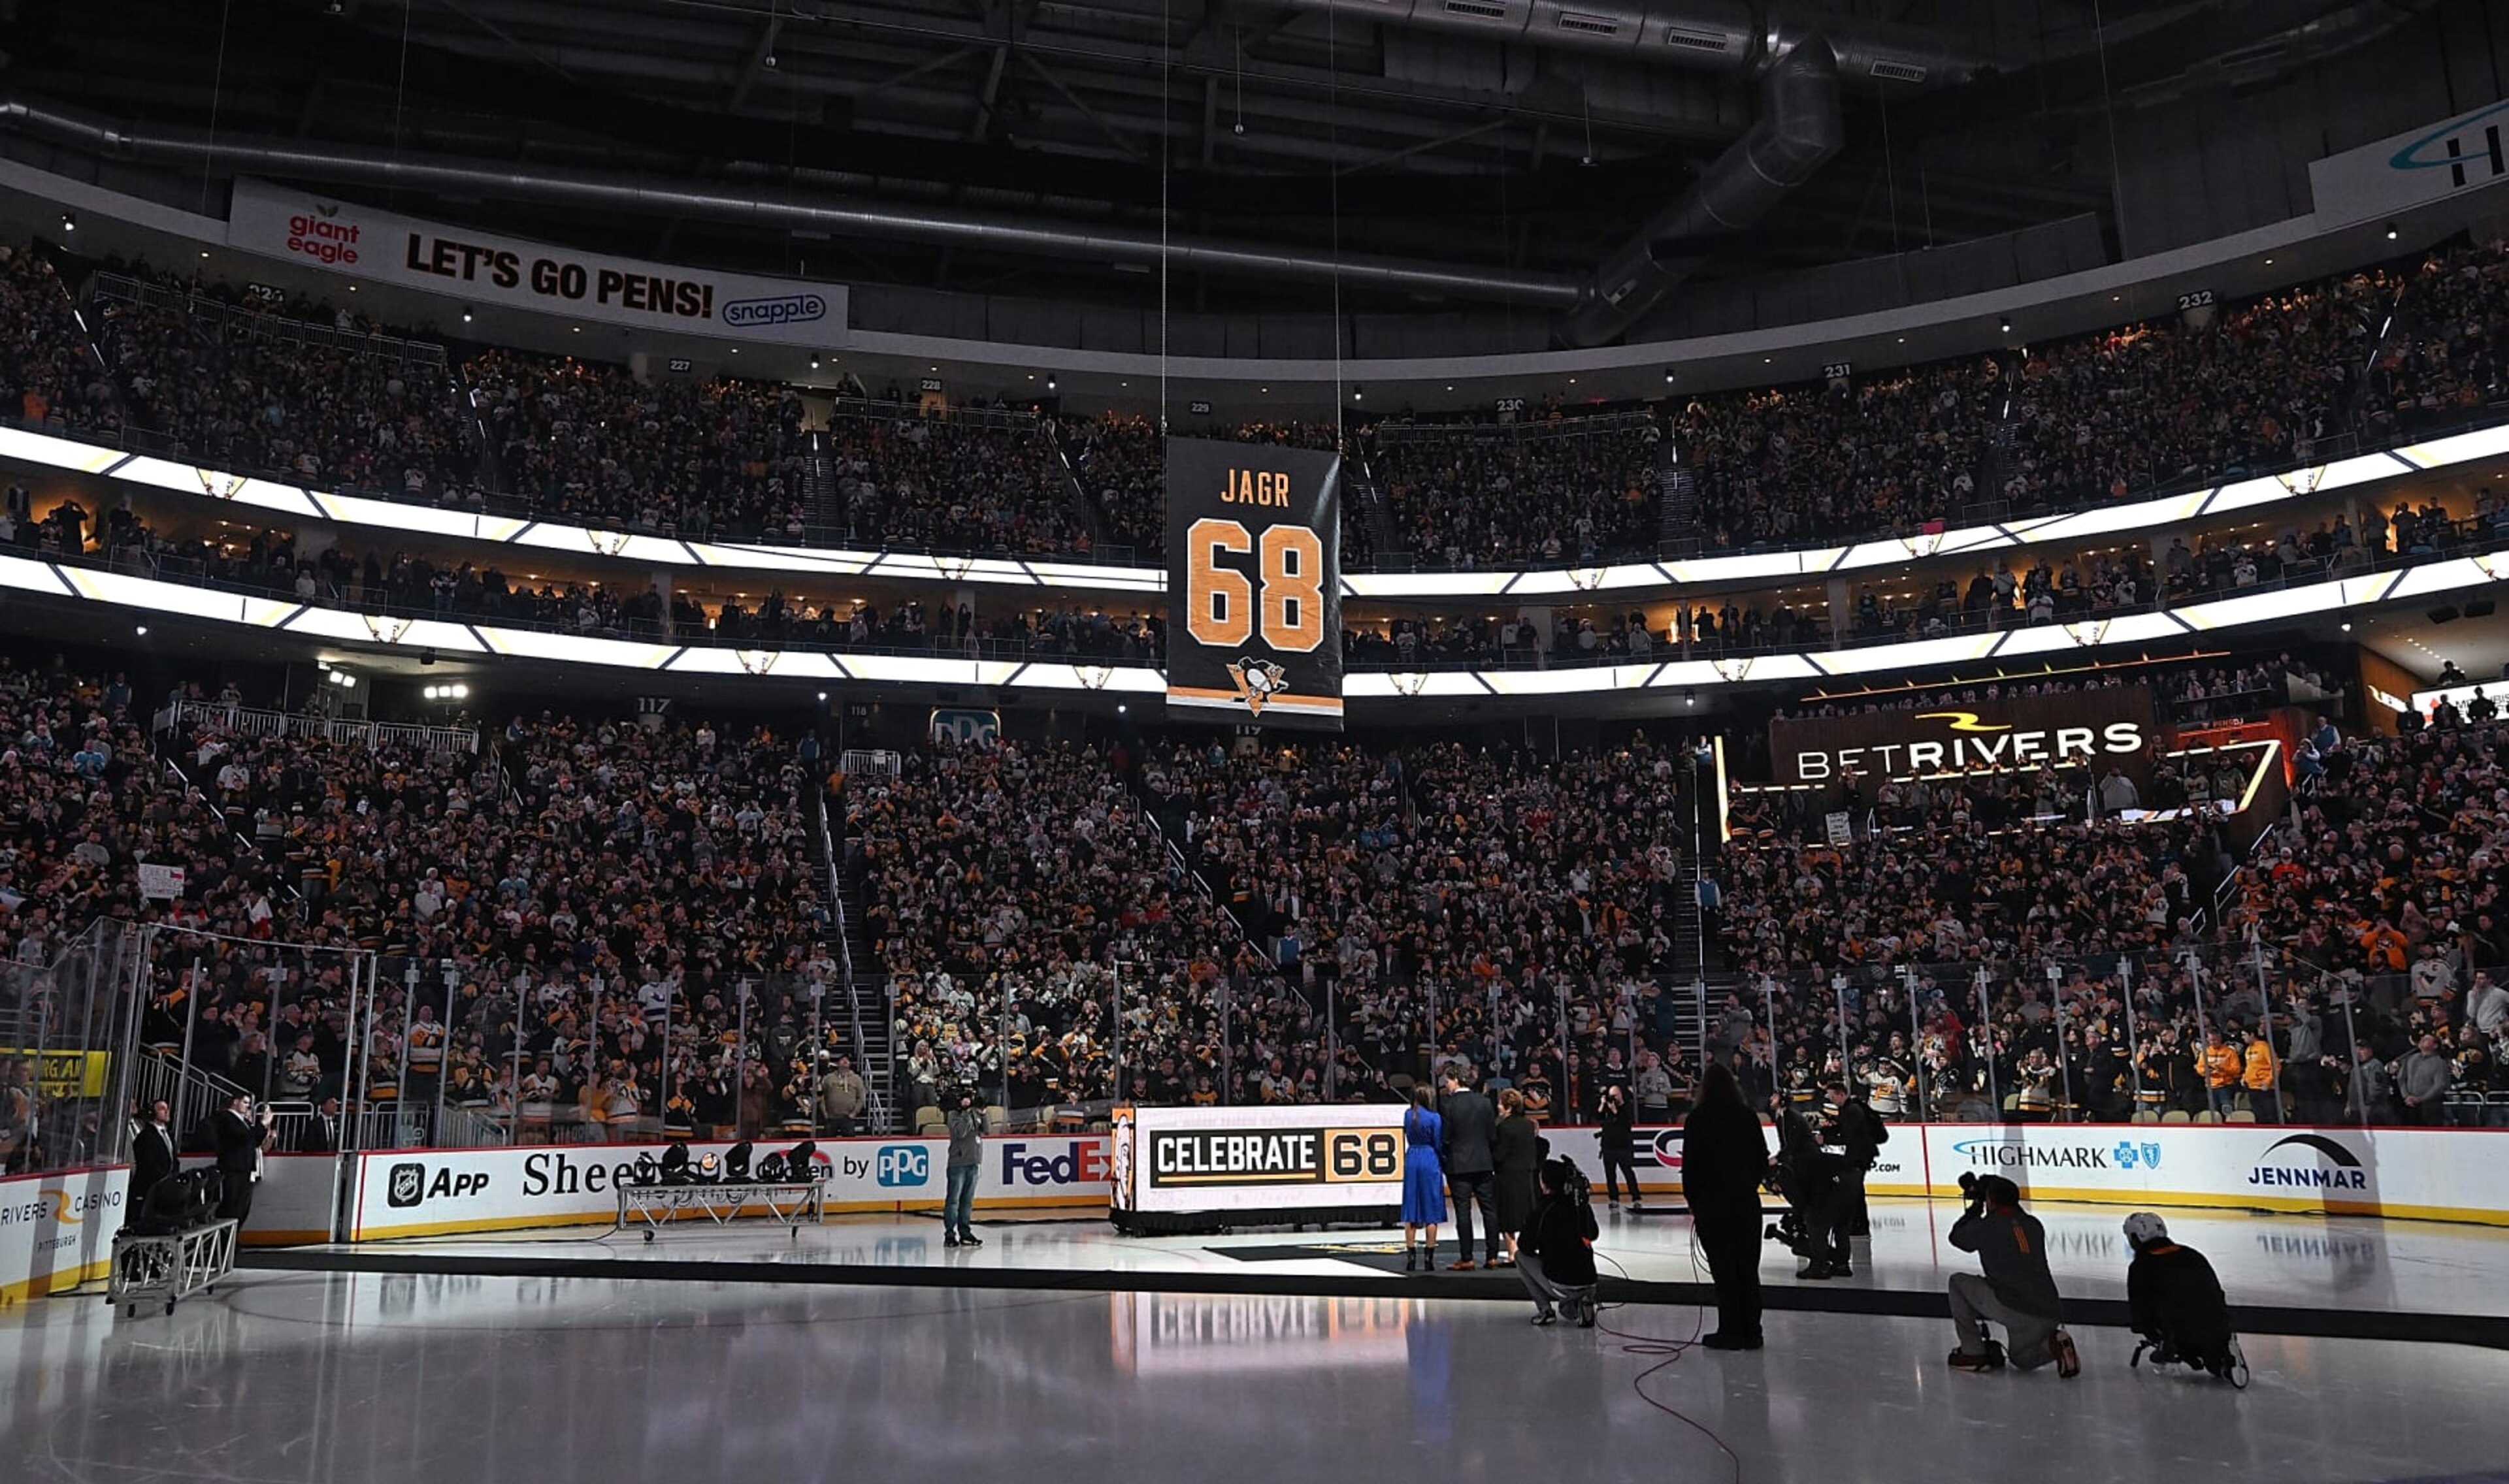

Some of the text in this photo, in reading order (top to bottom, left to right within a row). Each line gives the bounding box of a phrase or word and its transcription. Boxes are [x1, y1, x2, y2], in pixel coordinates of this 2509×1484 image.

[289, 215, 360, 244] giant
[287, 236, 358, 264] eagle
[406, 233, 714, 319] LET'S GO PENS!
[729, 295, 820, 323] snapple
[2179, 291, 2213, 310] 232
[670, 361, 691, 371] 227
[1825, 364, 1850, 378] 231
[1221, 468, 1289, 508] JAGR
[1187, 517, 1323, 653] 68
[638, 697, 670, 713] 117
[844, 1156, 870, 1176] by
[1157, 1133, 1398, 1177] CELEBRATE 68
[1968, 1145, 2107, 1169] HIGHMARK
[2248, 1167, 2367, 1189] JENNMAR
[1, 1191, 122, 1226] RIVERS CASINO
